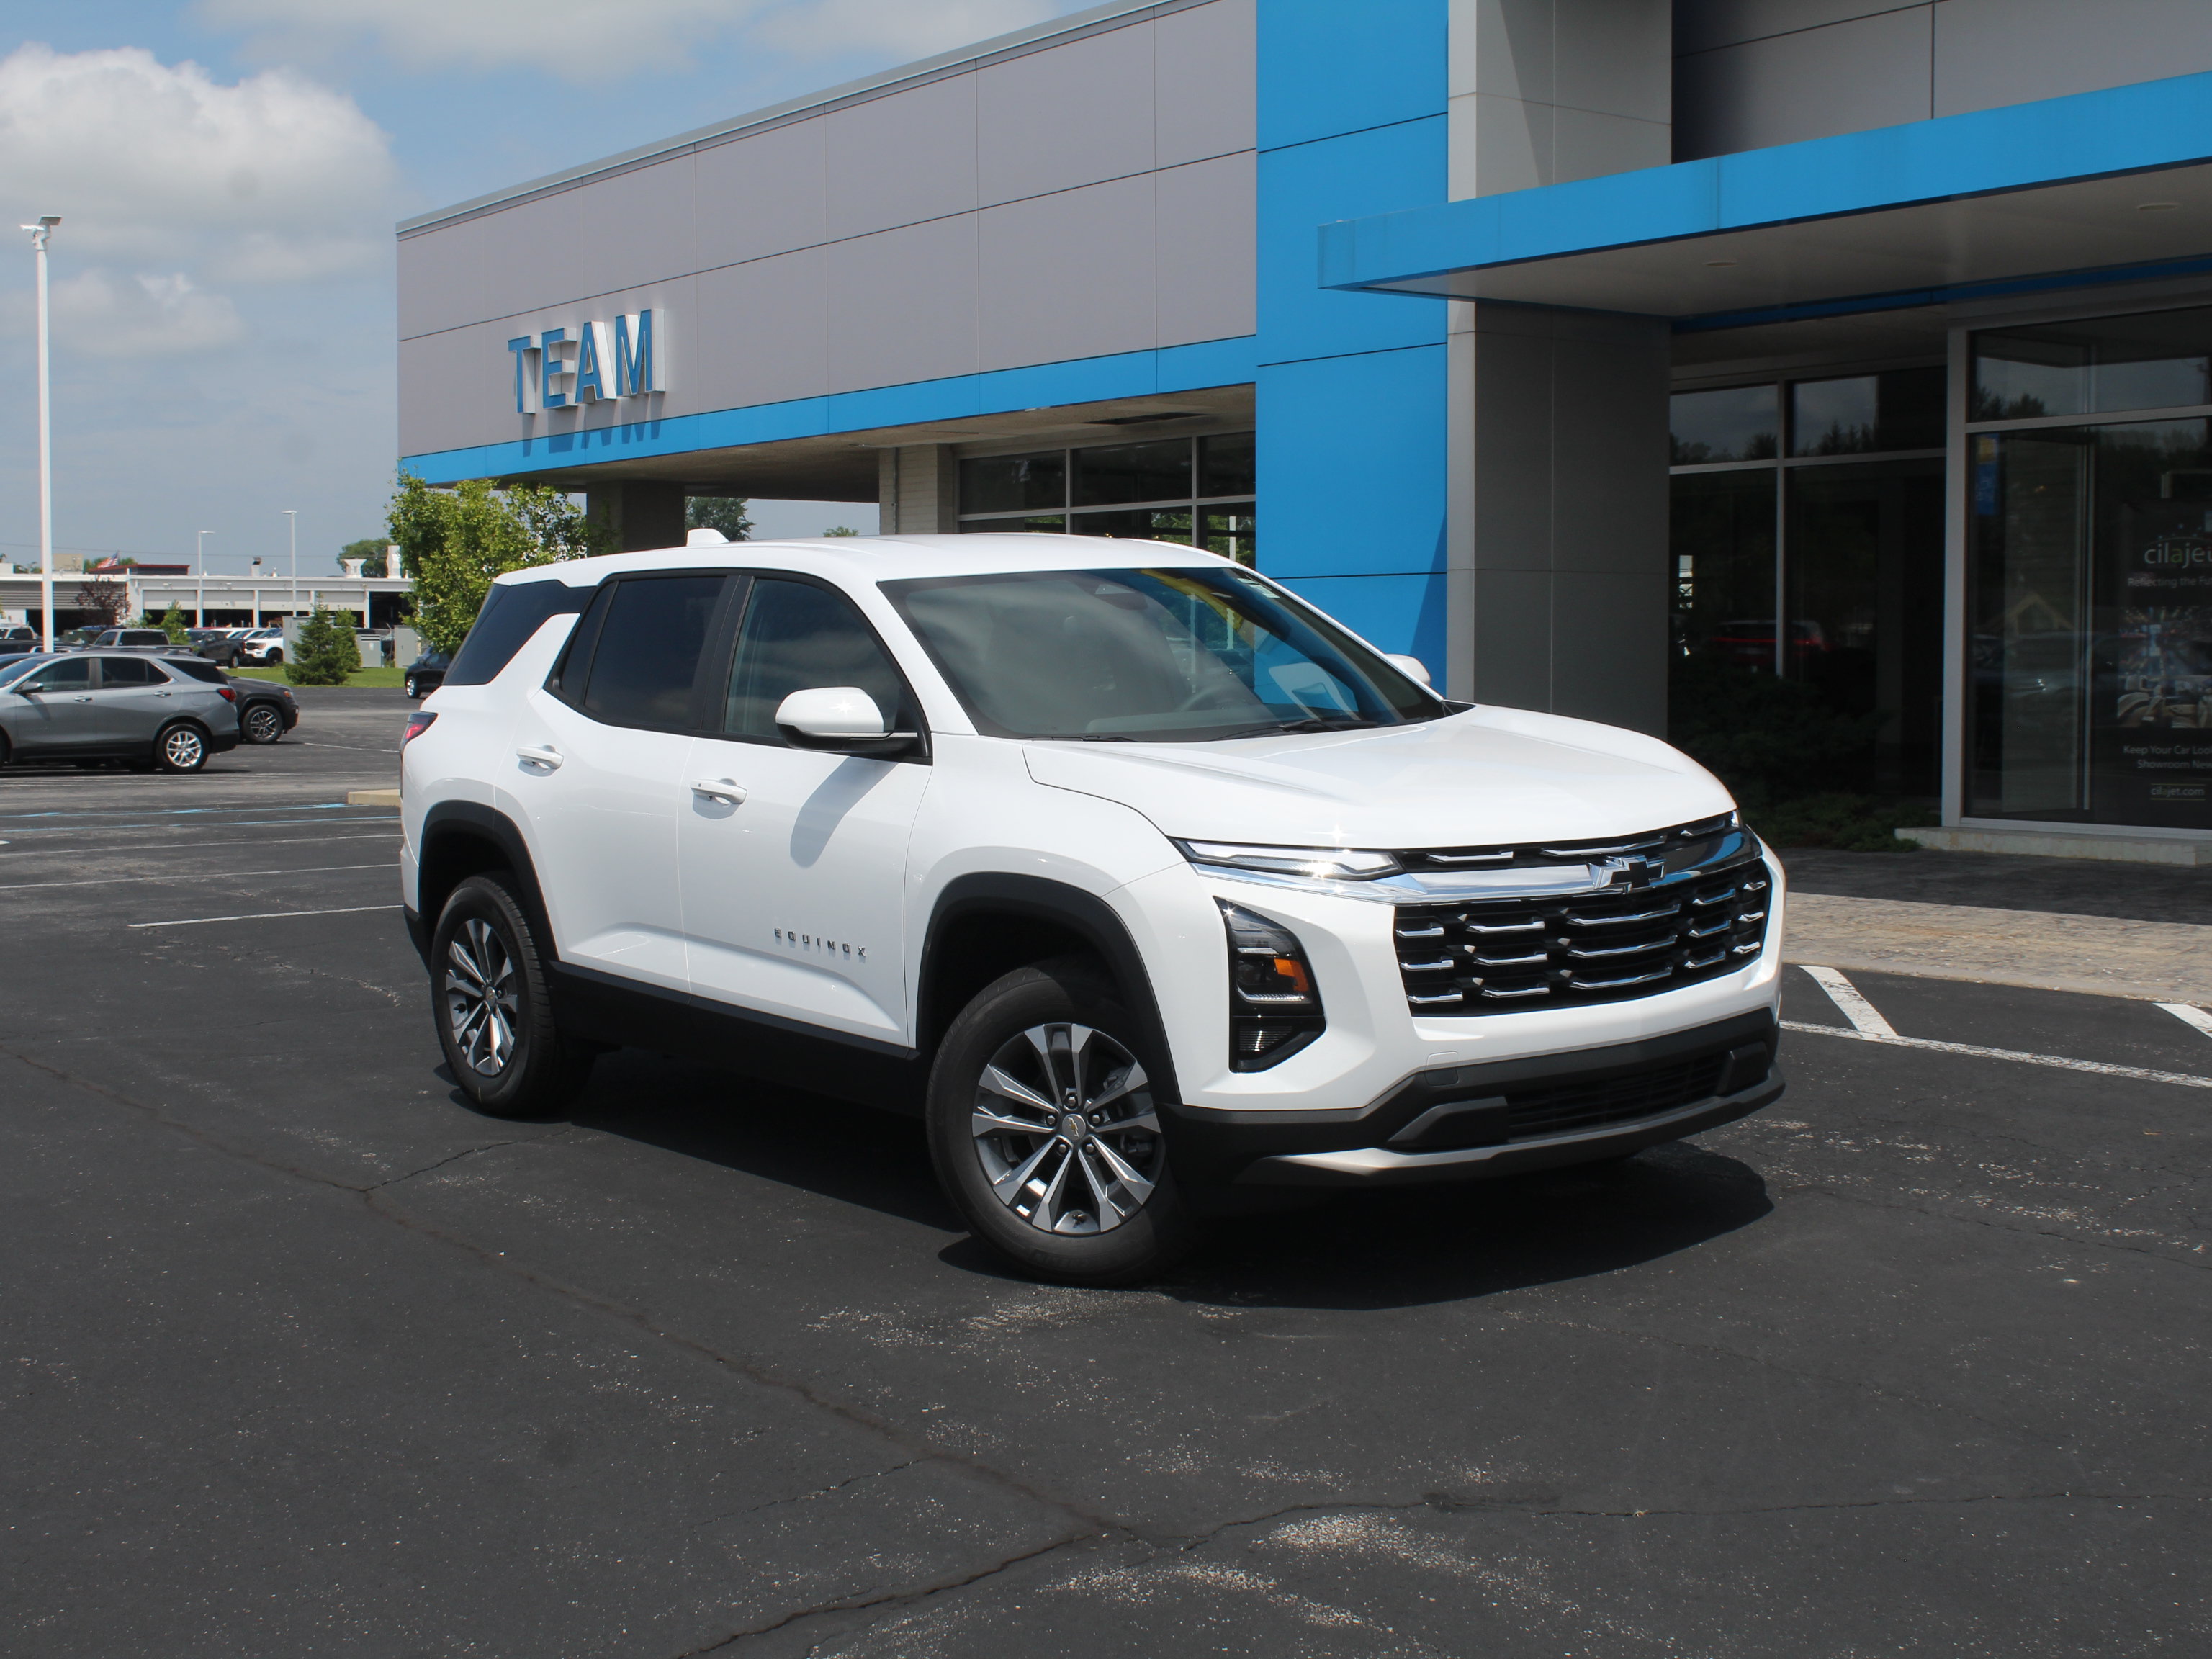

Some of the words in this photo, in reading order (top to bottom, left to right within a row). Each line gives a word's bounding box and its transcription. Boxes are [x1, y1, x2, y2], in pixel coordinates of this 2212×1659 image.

[507, 308, 665, 415] TEAM
[2128, 577, 2177, 588] Reflecting
[2180, 576, 2197, 587] the
[2122, 745, 2149, 756] Keep
[2149, 745, 2172, 755] Your
[2174, 745, 2190, 755] Car
[2137, 759, 2190, 769] Showroom
[2151, 786, 2205, 797] cilajet.com
[773, 927, 867, 958] EQUINOX
